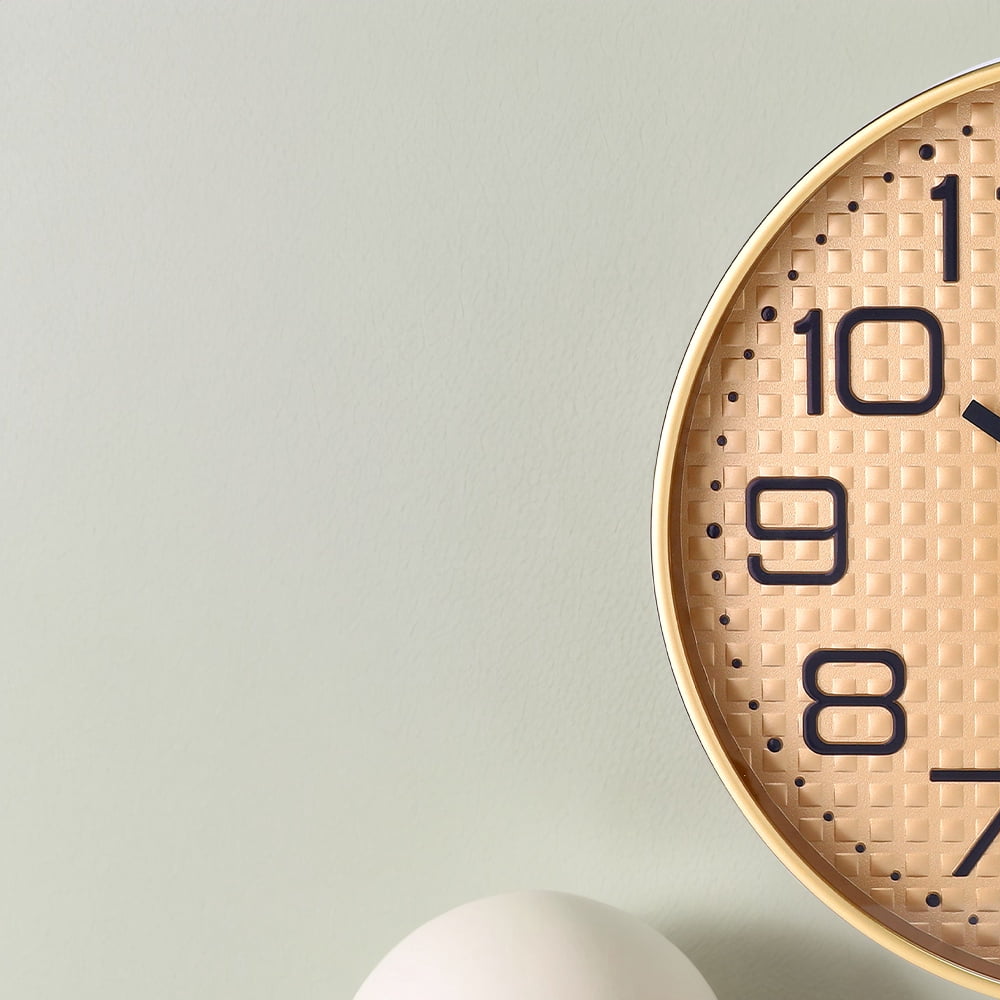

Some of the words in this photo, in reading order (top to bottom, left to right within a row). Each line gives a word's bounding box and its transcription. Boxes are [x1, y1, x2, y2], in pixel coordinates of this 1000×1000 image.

[793, 305, 945, 416] 10
[745, 475, 848, 587] 9
[801, 649, 907, 757] 8
